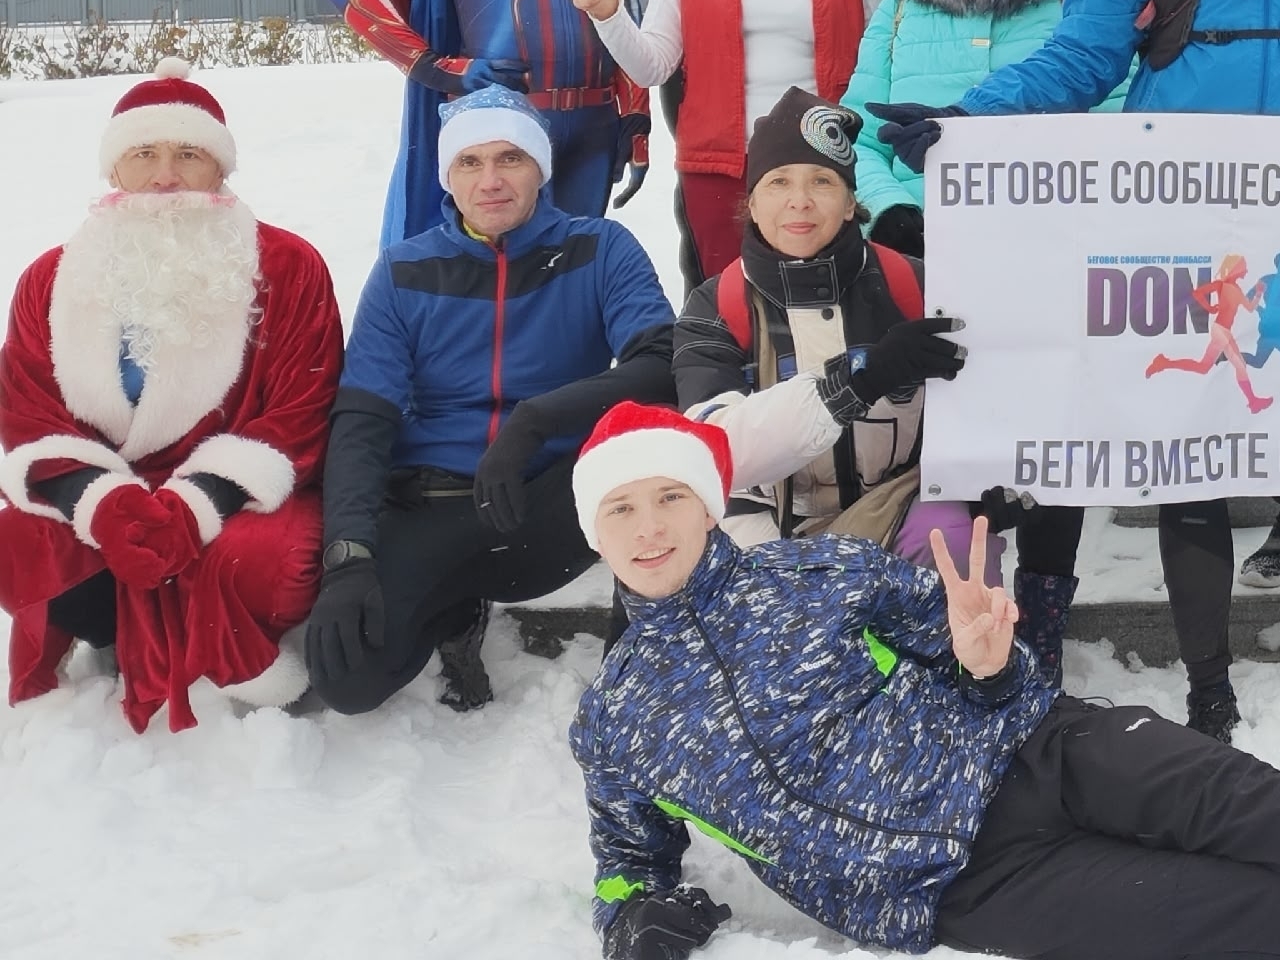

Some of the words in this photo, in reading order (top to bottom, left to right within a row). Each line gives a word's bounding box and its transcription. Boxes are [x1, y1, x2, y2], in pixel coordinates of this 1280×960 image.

[940, 160, 1099, 207] БЕГОВОЕ
[1087, 255, 1119, 265] БЕГОВОЕ
[1120, 255, 1171, 265] СООБЩЕСТВО
[1172, 255, 1212, 265] ДОНБАССА
[1086, 265, 1212, 337] DON
[1013, 440, 1110, 488] БЕГИ
[1124, 432, 1269, 488] ВМЕСТЕ
